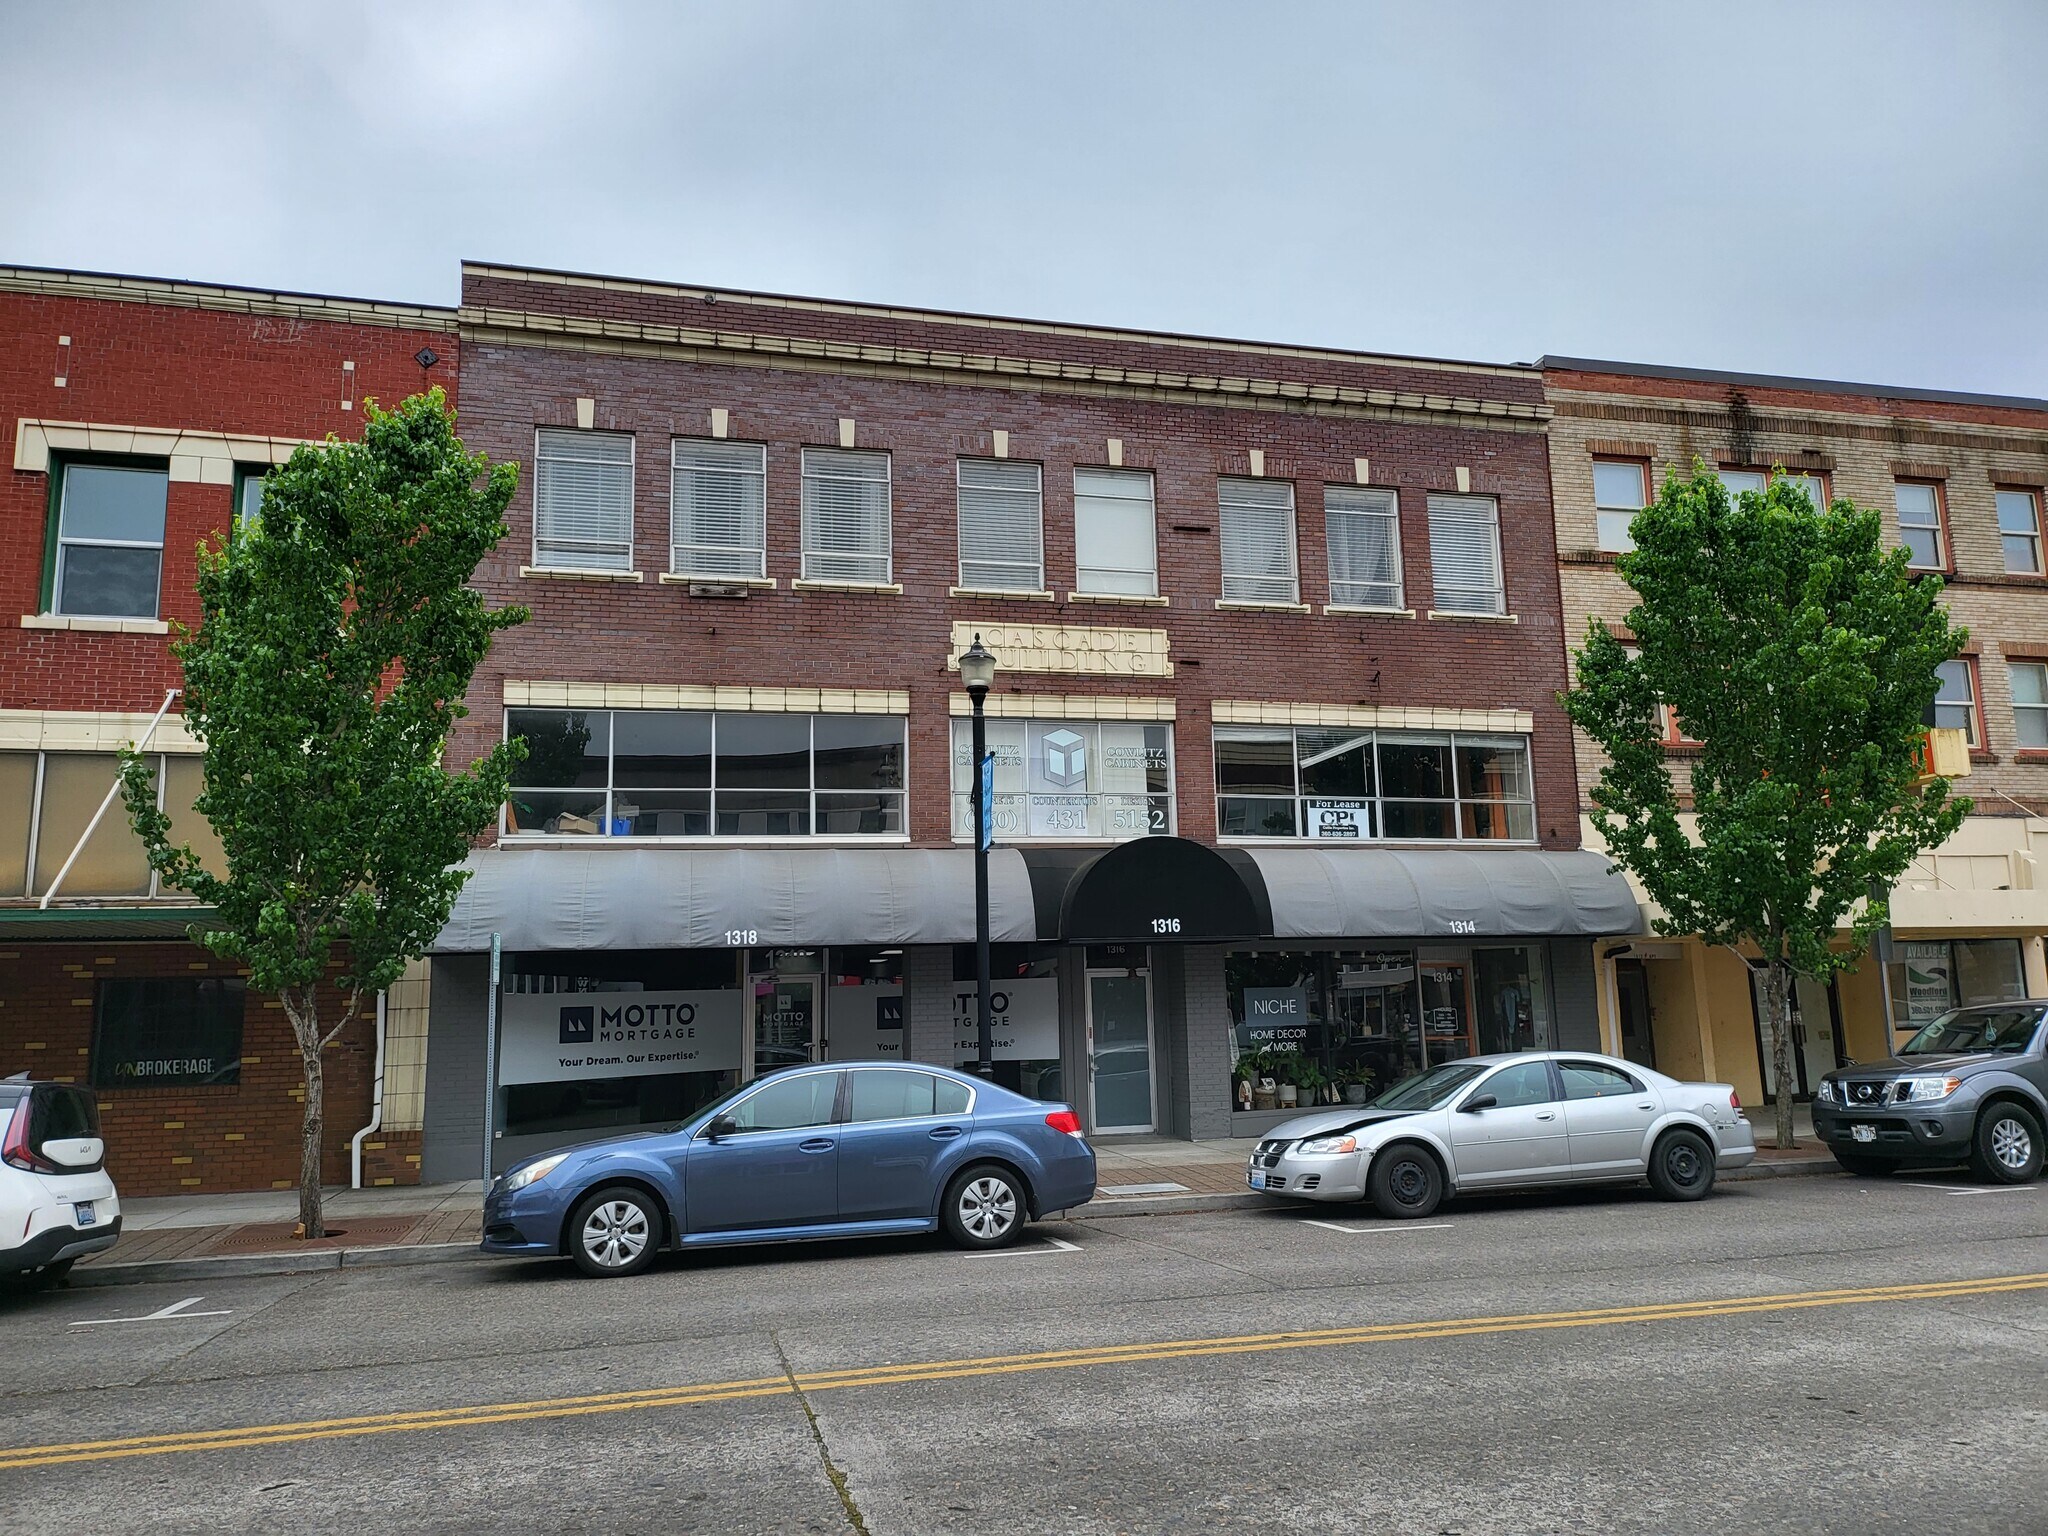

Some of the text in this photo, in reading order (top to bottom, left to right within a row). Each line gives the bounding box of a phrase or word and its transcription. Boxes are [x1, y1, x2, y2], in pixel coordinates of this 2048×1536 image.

[985, 628, 1138, 652] CASCADE
[1000, 648, 1147, 672] UILDING
[1106, 747, 1164, 757] COWLITZ
[1104, 759, 1167, 769] CABINETS
[1047, 809, 1086, 829] 431
[1113, 809, 1165, 829] 5152
[1151, 918, 1181, 933] 1316
[1449, 920, 1476, 933] 1314
[724, 930, 758, 945] 1318
[1106, 945, 1126, 954] 1316
[1906, 945, 1947, 958] AVAILABLE
[1433, 972, 1453, 982] 1314
[1254, 999, 1298, 1014] NICHE
[600, 1003, 696, 1028] MOTTO
[763, 1011, 804, 1022] MOTTO
[600, 1028, 695, 1042] MORTGAGE
[1250, 1029, 1307, 1040] HOME DECOR
[877, 1043, 899, 1051] Your
[961, 1039, 1012, 1049] Exptise.
[1273, 1042, 1298, 1052] MORE
[559, 1051, 697, 1067] Your Dream. Our Expertise.
